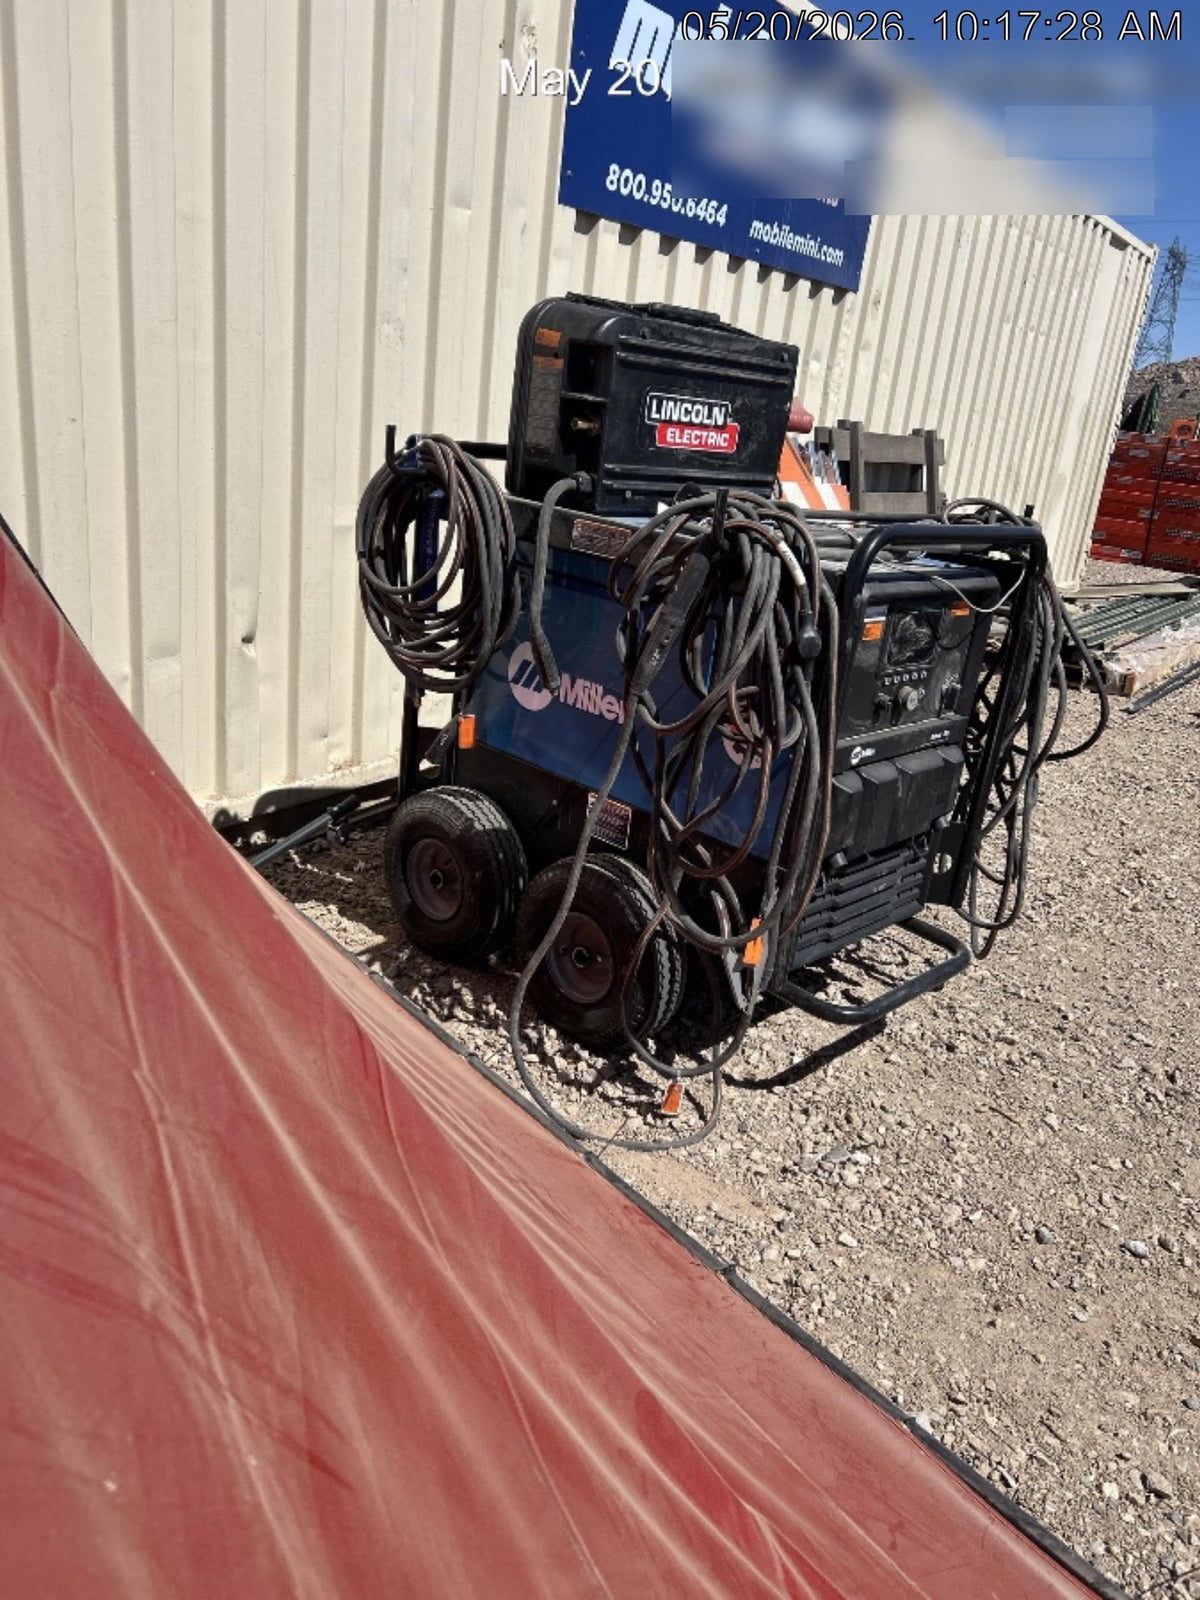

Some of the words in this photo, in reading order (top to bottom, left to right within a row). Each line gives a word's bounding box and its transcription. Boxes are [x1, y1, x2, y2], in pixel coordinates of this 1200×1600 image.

[749, 218, 844, 267] mobilemini.com
[650, 398, 726, 427] LINCOLN
[666, 427, 730, 448] ELECTRIC
